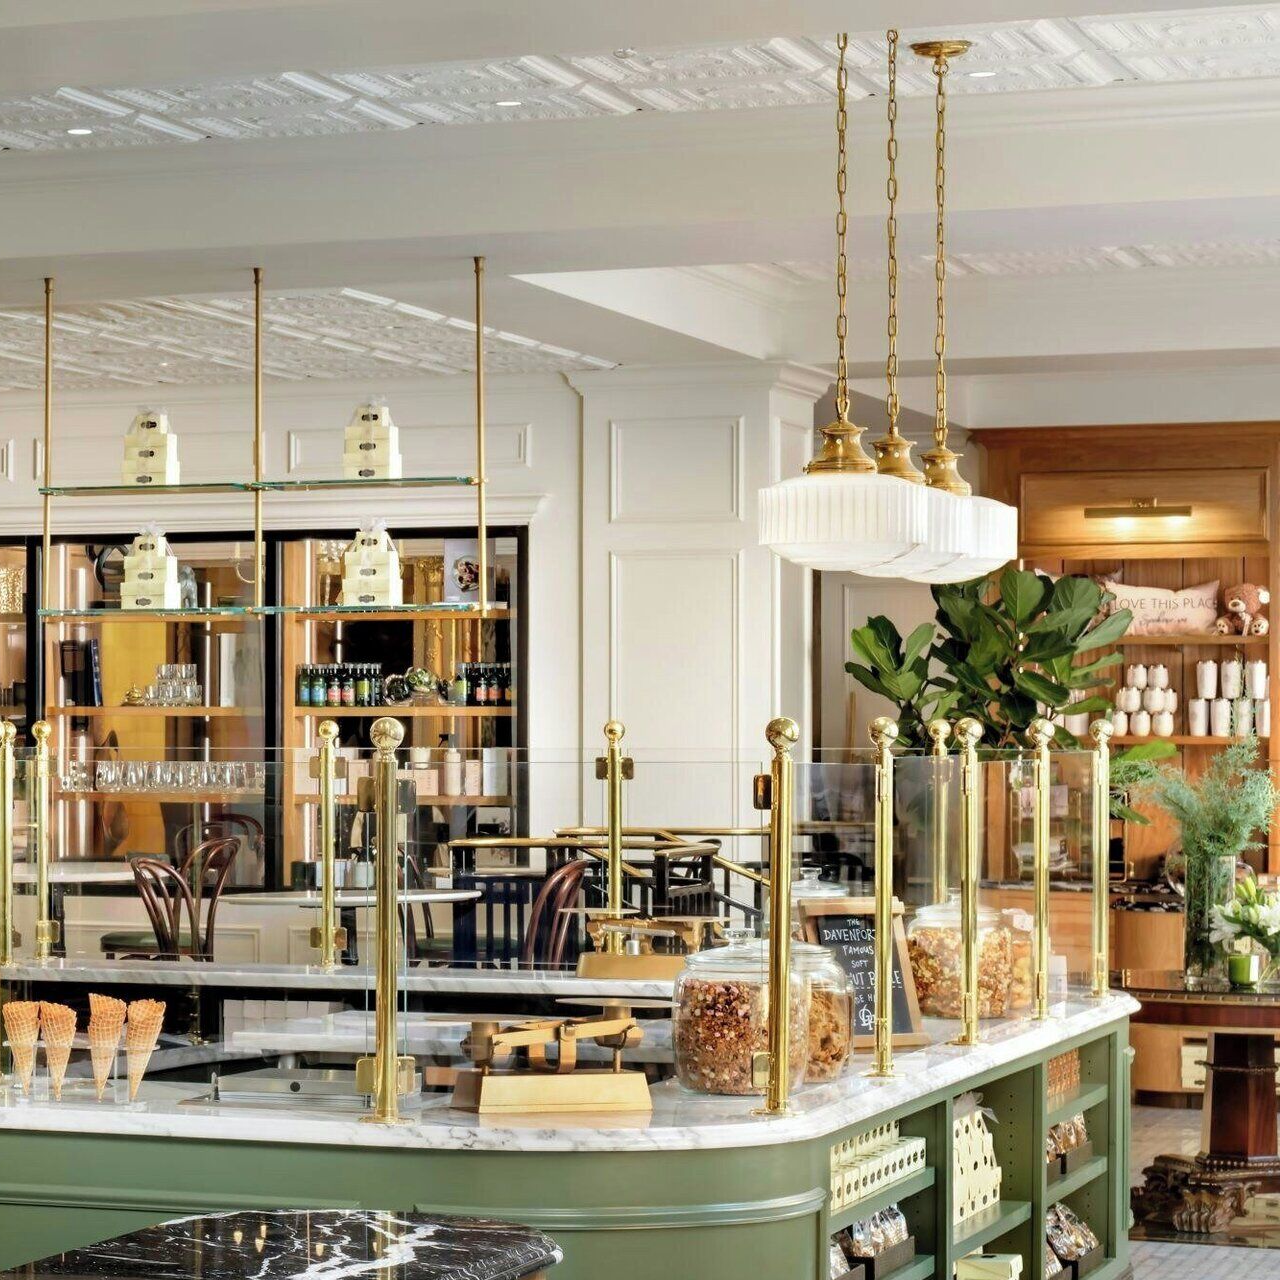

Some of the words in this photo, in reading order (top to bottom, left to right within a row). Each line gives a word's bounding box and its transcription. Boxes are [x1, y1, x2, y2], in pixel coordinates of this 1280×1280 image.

[1114, 598, 1146, 610] LOVE
[1152, 598, 1178, 609] THIS
[823, 929, 875, 941] DAVENPOR
[842, 945, 874, 955] FAMOUS
[851, 960, 868, 968] SOFT
